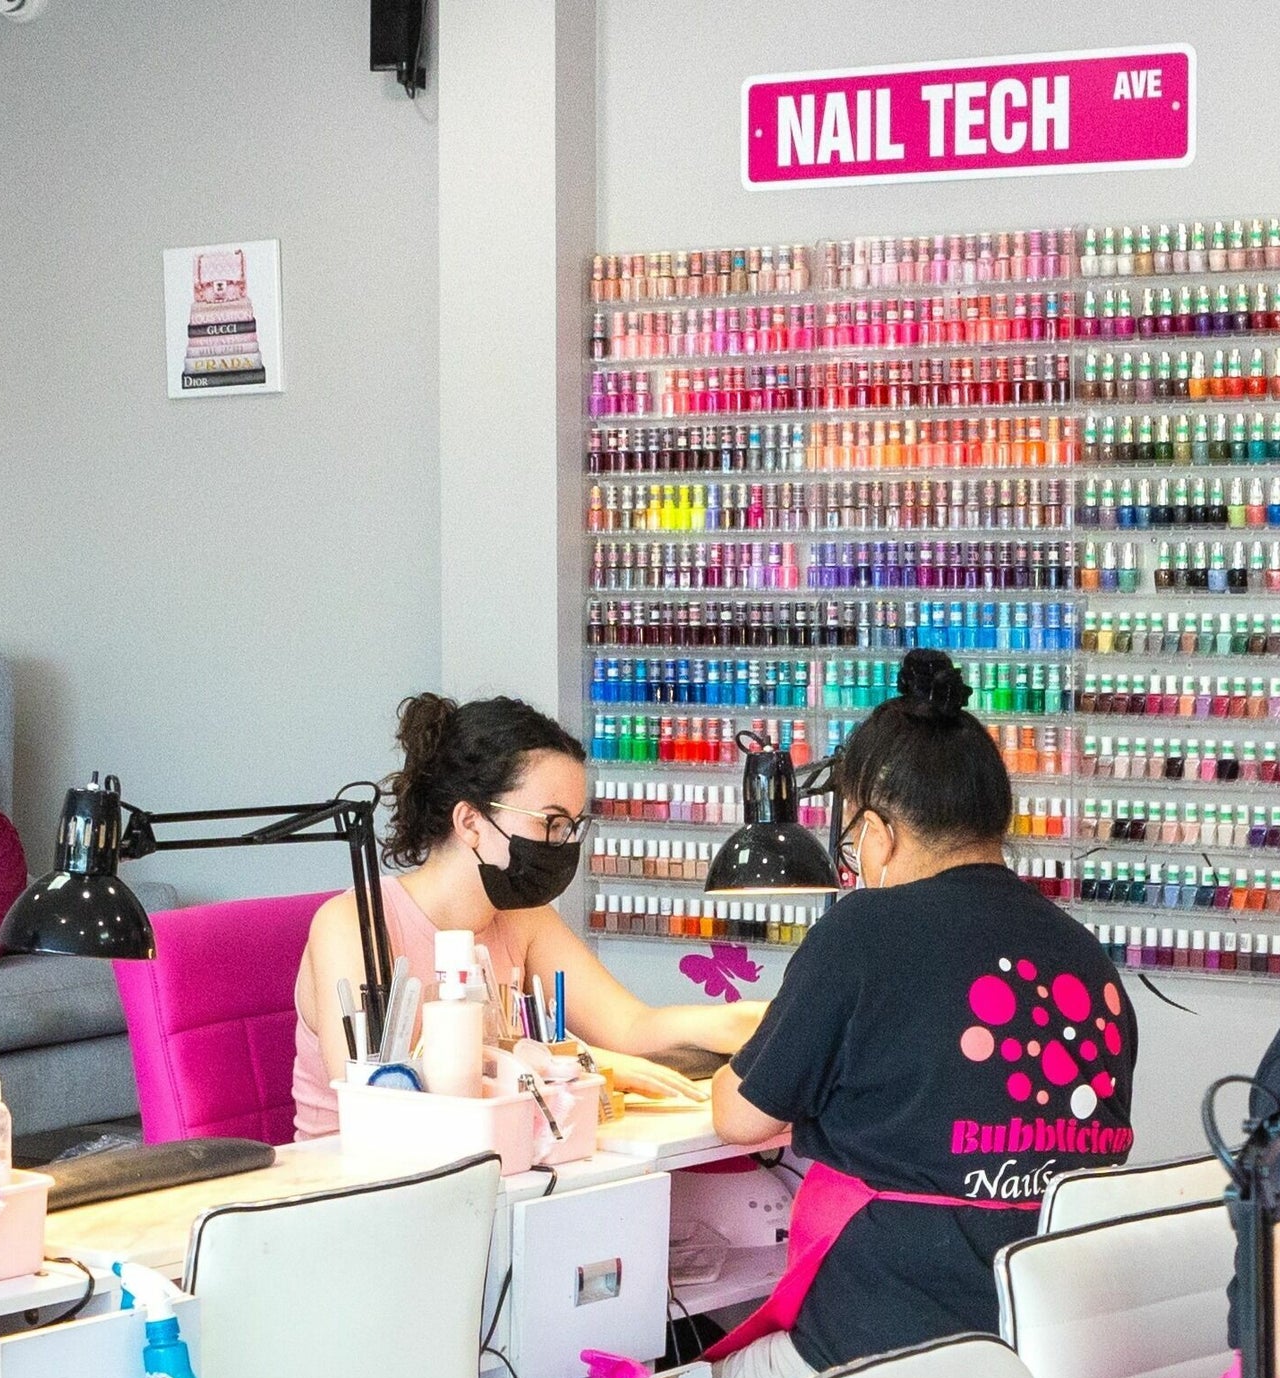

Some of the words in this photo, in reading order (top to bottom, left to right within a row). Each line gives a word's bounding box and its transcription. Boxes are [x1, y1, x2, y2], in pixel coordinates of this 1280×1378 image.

[777, 88, 904, 167] NAIL
[921, 75, 1070, 157] TECH
[1113, 69, 1162, 100] AVE
[207, 324, 237, 334] GUCCI
[195, 358, 253, 371] PRADA
